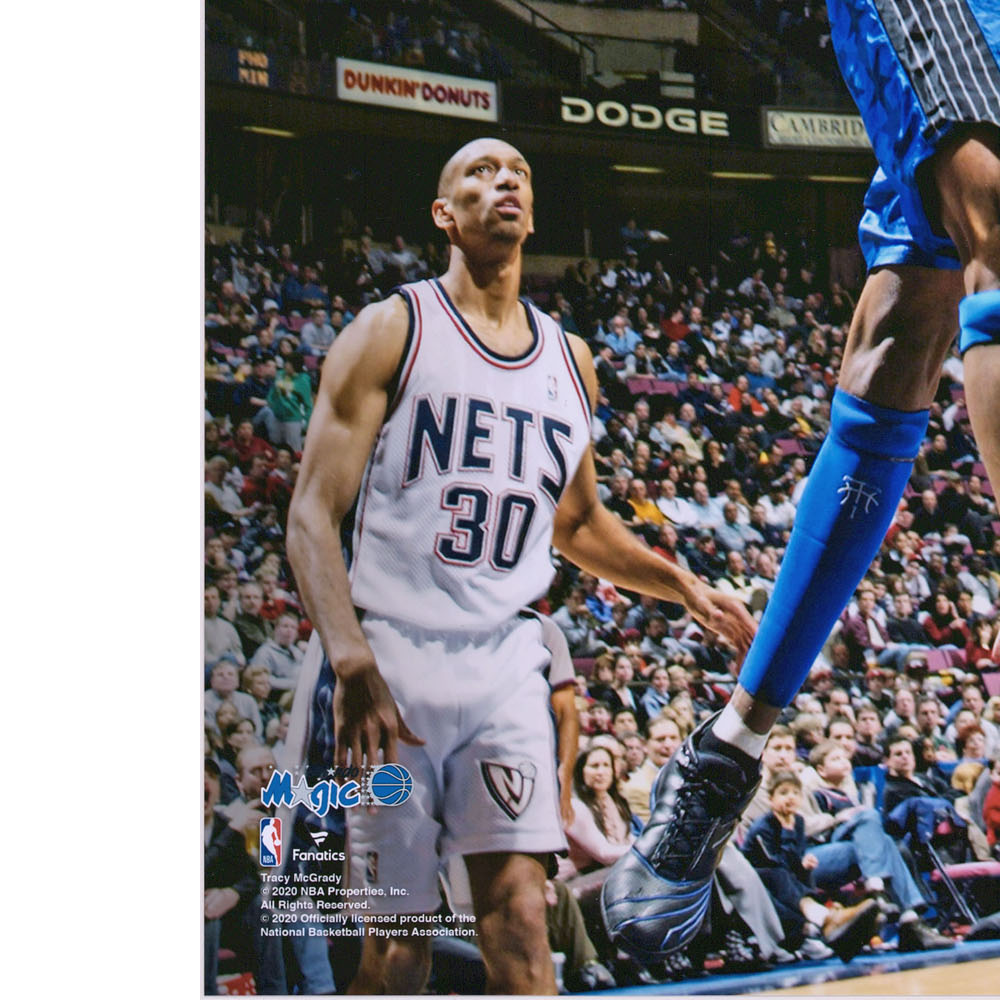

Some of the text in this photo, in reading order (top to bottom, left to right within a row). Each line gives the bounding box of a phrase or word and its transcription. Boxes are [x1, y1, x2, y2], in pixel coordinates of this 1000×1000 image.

[343, 69, 490, 110] DUNKIN' DONUTS
[561, 96, 730, 137] DODGE
[770, 112, 867, 136] CAMBRID
[402, 393, 573, 511] NETS
[434, 481, 538, 572] 30
